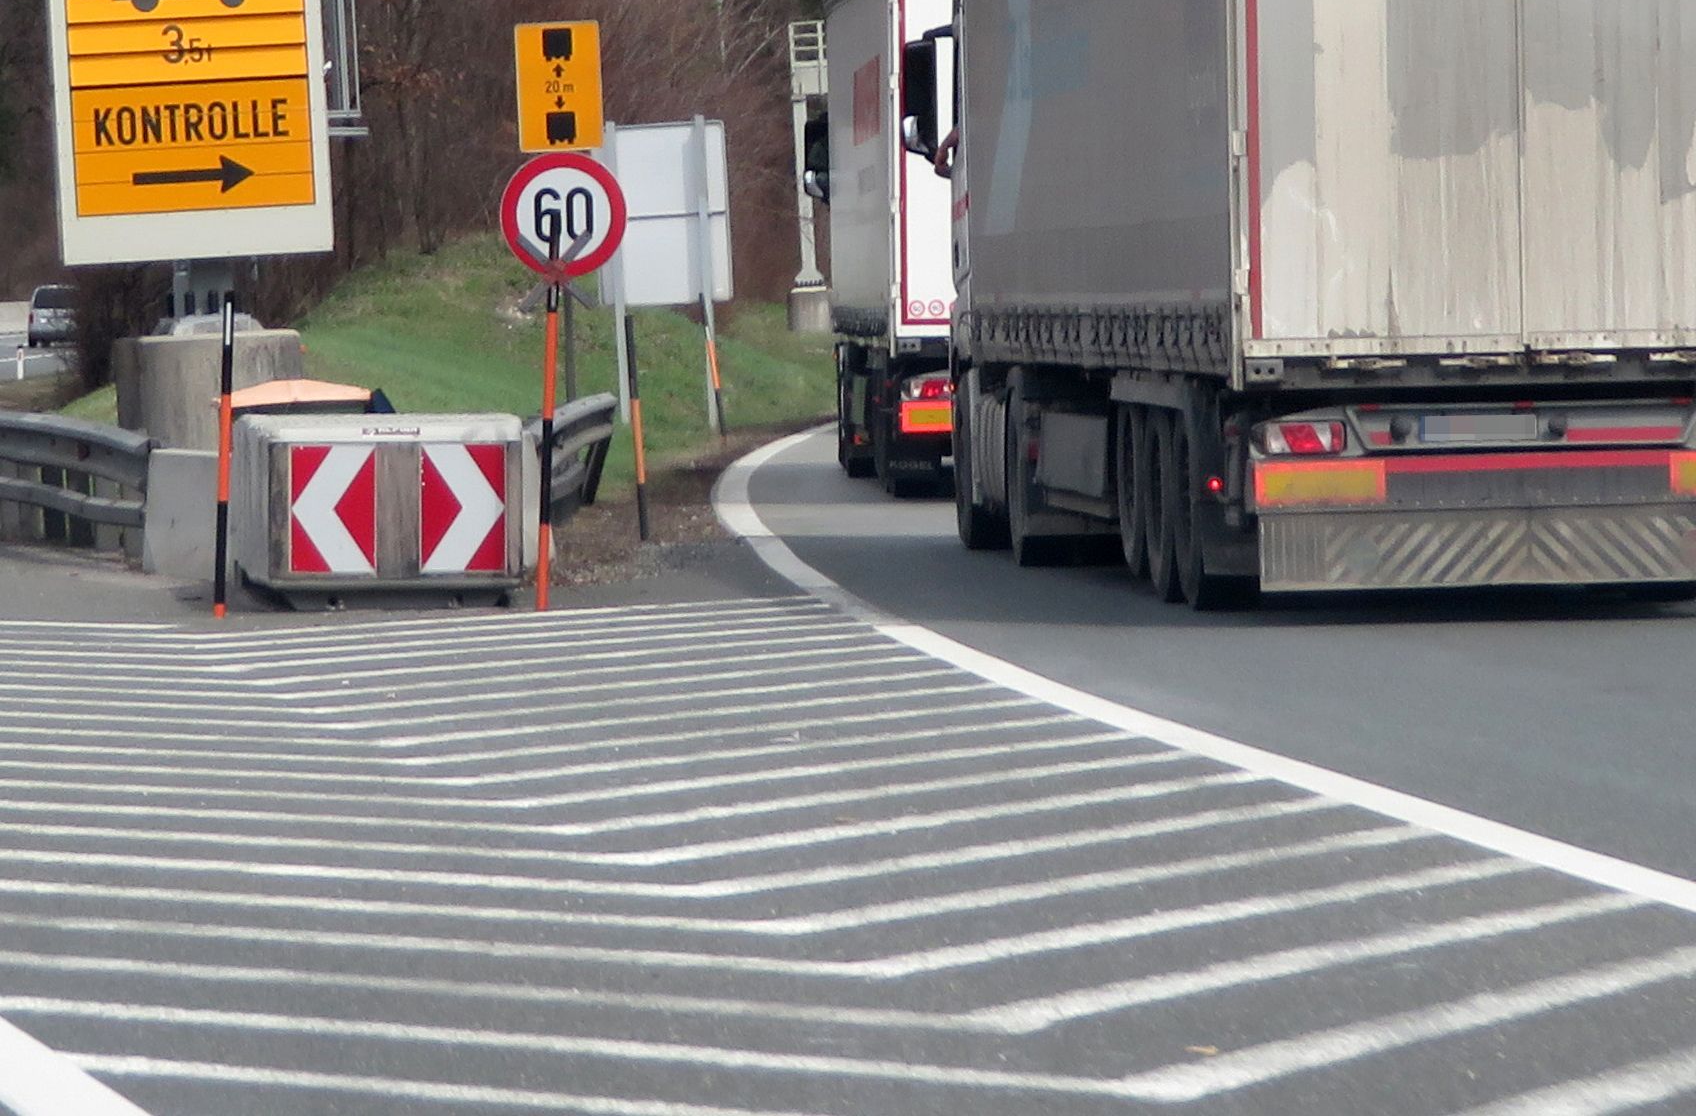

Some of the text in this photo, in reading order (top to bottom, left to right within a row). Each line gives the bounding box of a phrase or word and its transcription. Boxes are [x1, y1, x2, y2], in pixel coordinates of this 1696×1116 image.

[545, 80, 574, 94] 20 m
[93, 97, 290, 147] KONTROLLE
[533, 186, 594, 245] 60
